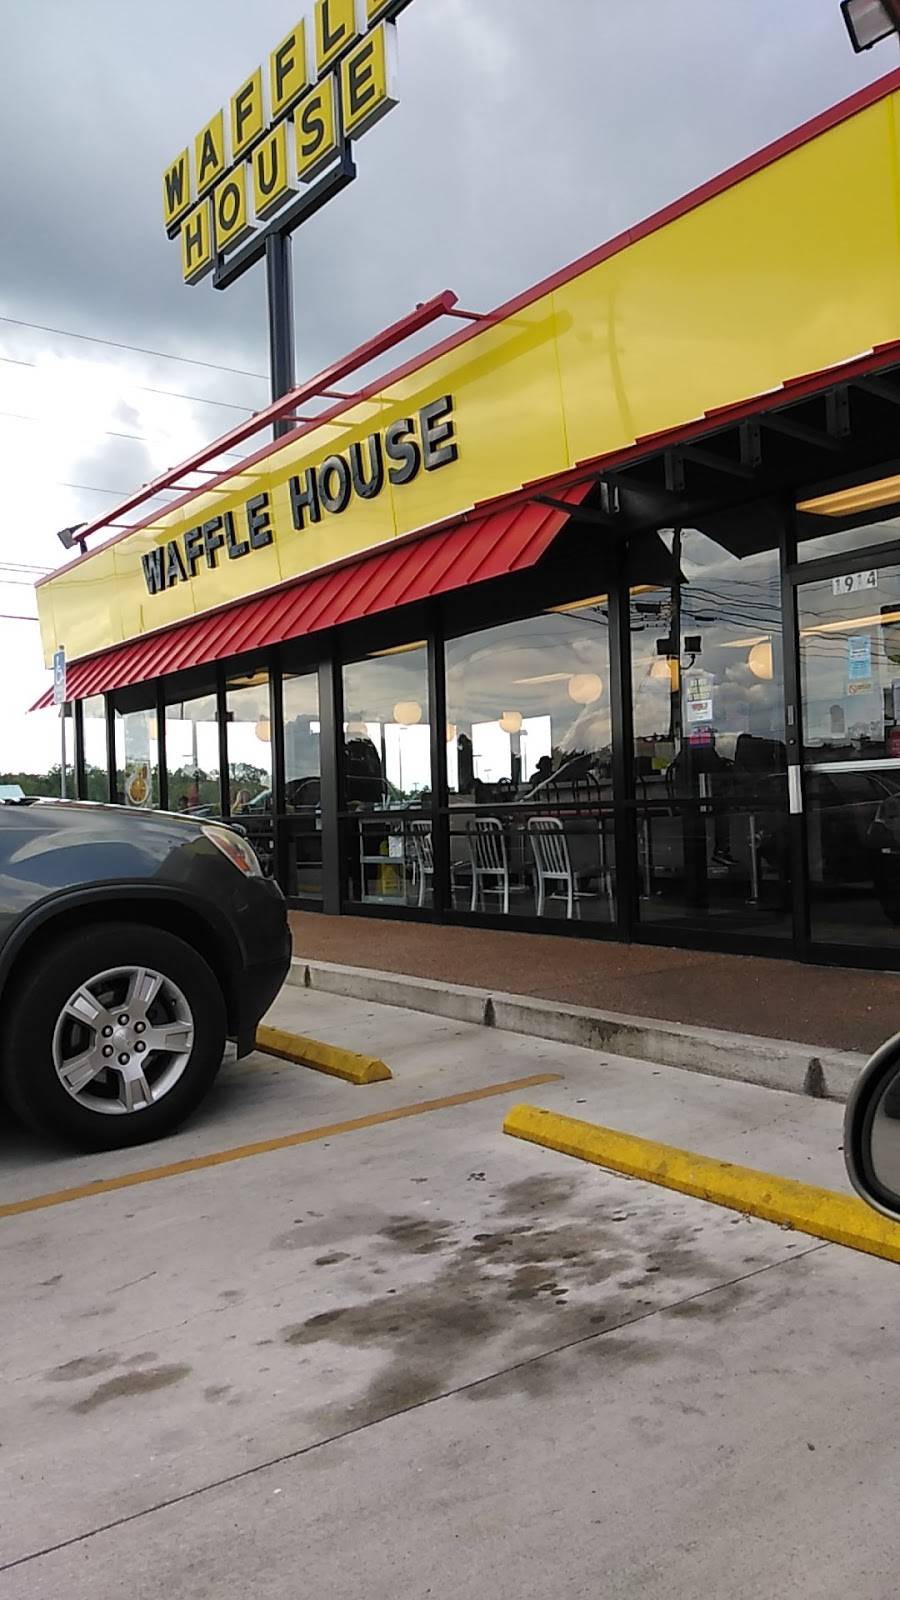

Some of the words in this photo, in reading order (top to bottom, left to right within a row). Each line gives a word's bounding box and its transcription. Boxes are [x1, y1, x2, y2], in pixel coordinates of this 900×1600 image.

[164, 0, 378, 214] WAFFL
[185, 41, 375, 268] HOUSE
[141, 492, 273, 594] WAFFLE
[289, 394, 458, 530] HOUSE
[834, 571, 876, 592] 1914
